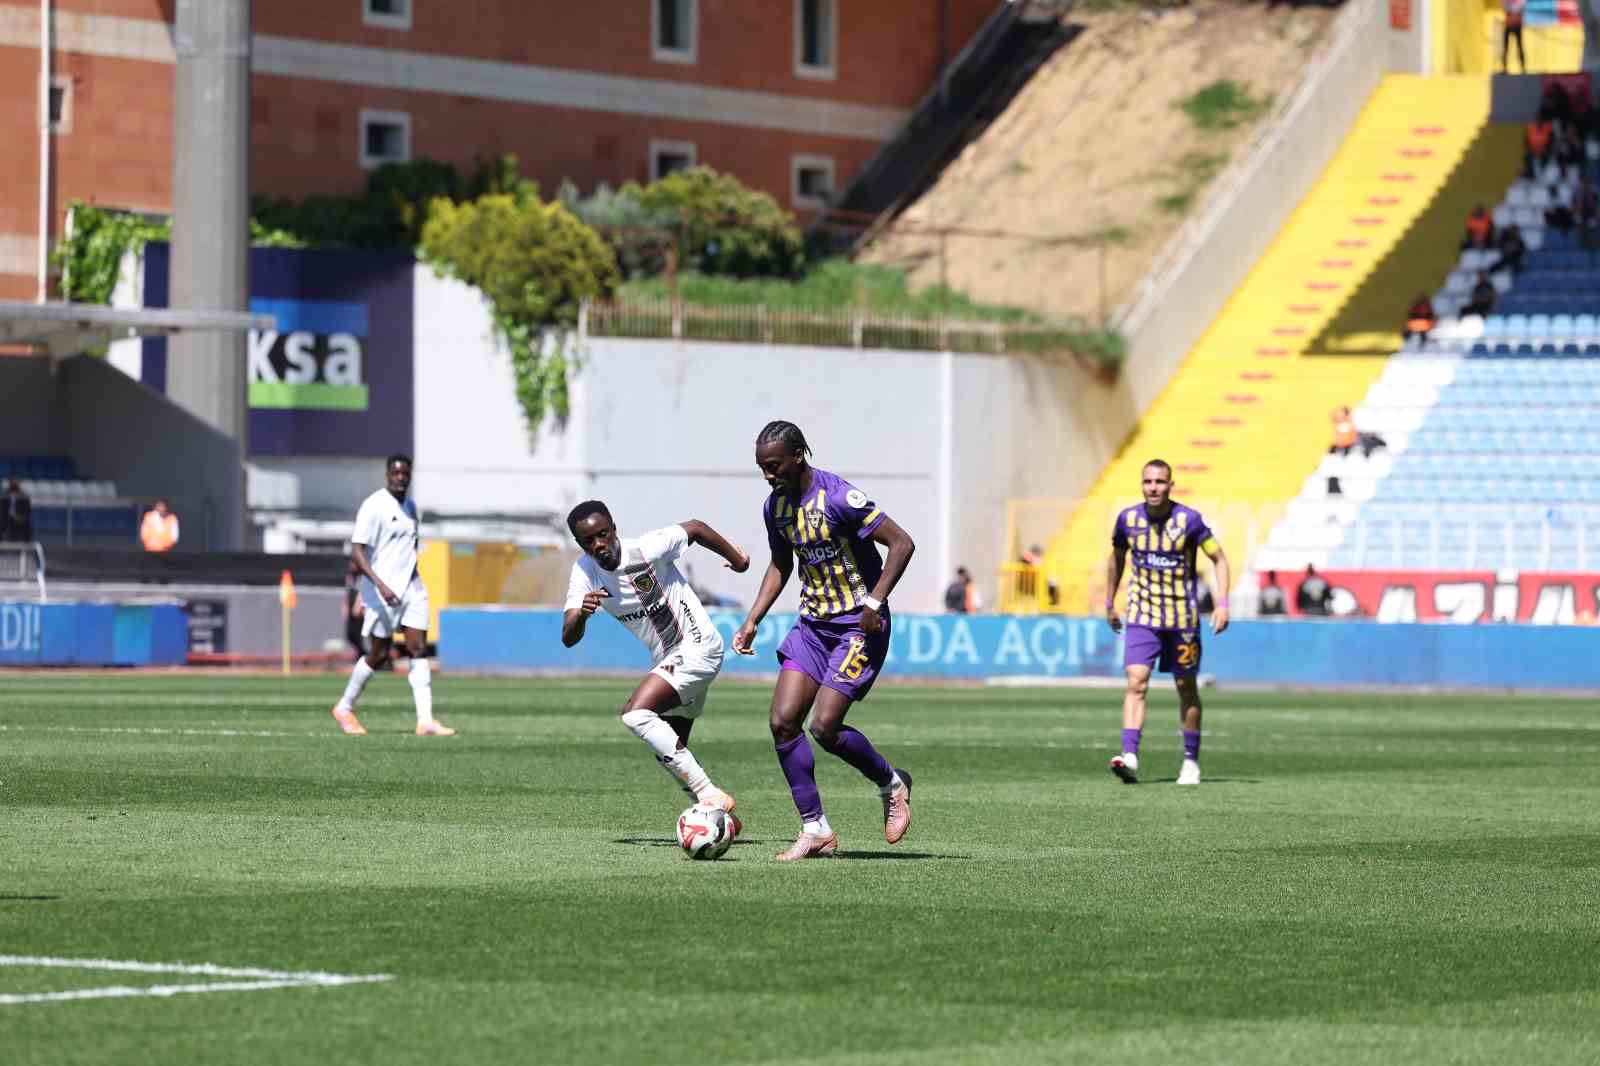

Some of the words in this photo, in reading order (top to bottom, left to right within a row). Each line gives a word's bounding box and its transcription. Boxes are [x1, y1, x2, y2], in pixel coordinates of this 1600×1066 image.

[247, 329, 361, 384] ksa
[2, 604, 40, 656] DI!
[838, 642, 869, 680] 15
